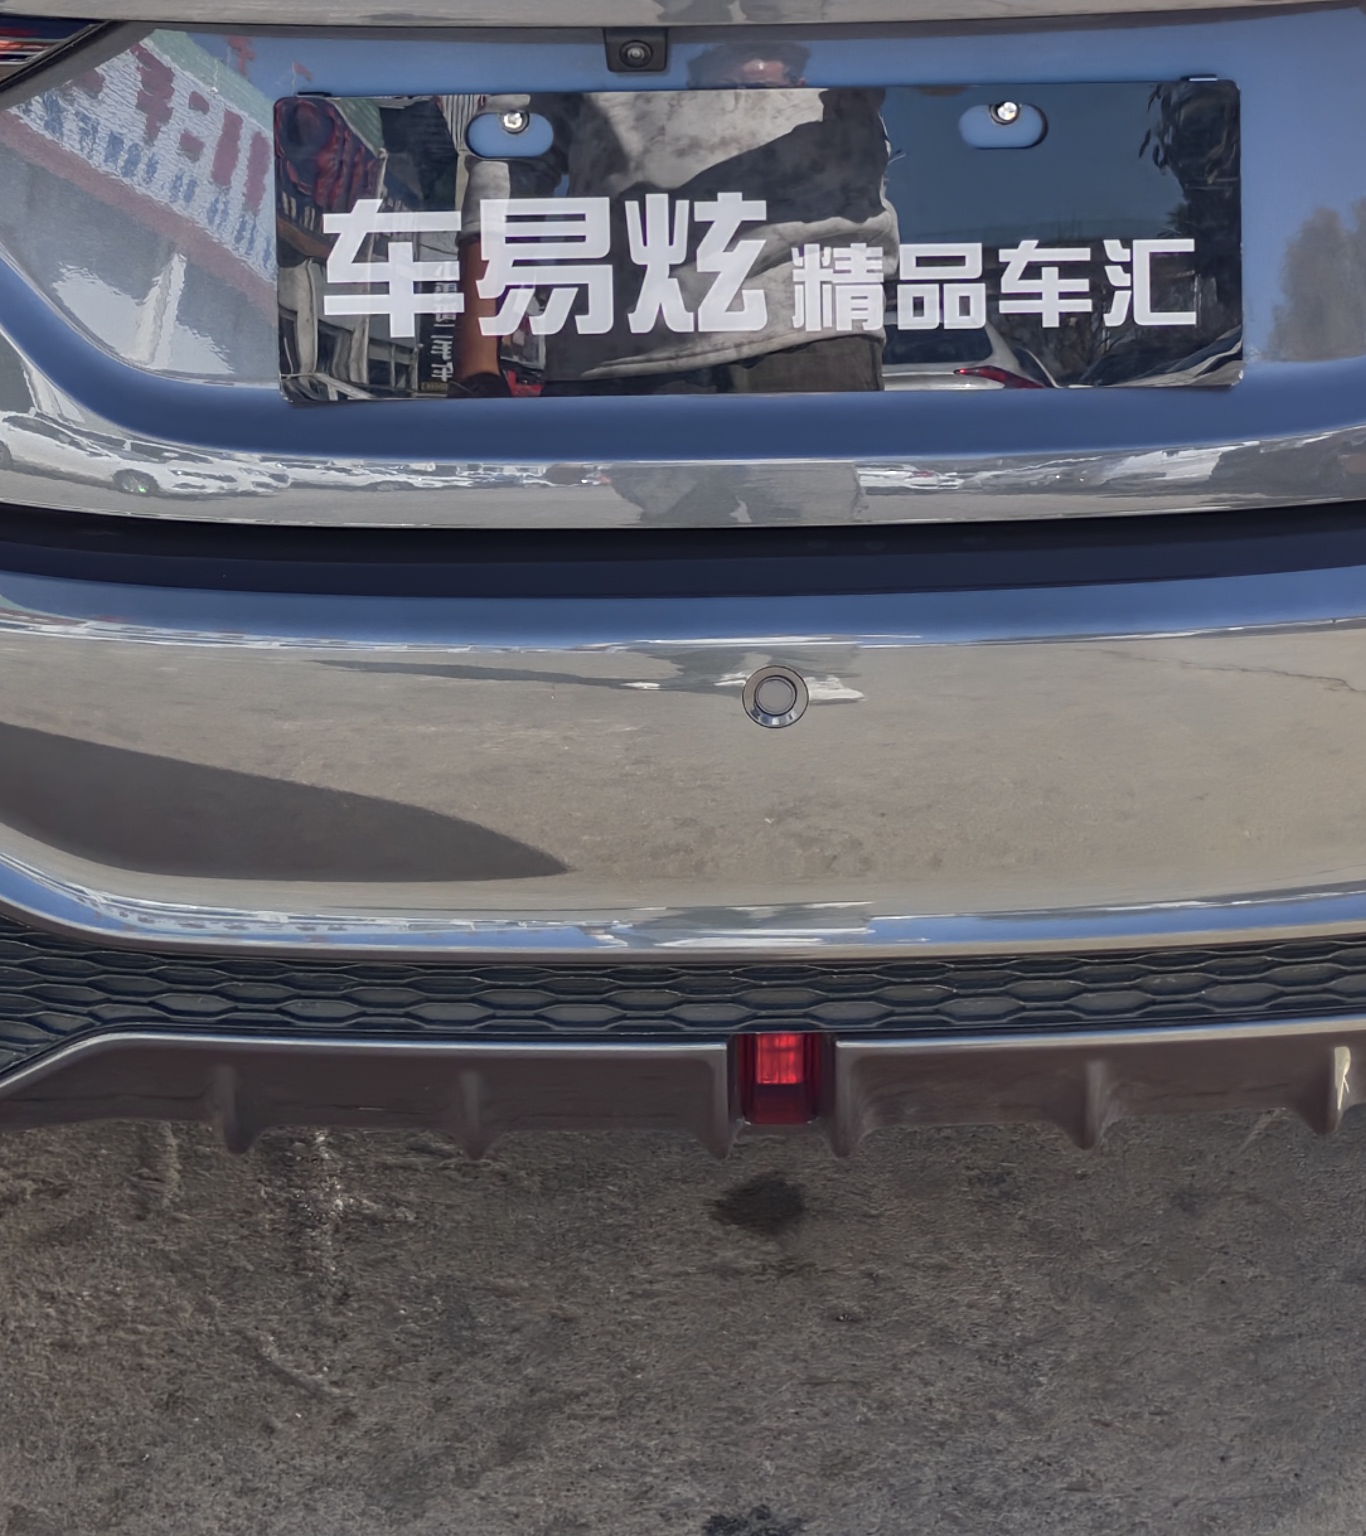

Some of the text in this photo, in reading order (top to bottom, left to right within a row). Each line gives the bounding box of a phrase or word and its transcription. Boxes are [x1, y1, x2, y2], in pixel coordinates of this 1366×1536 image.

[321, 191, 769, 339] 车易炫
[790, 237, 1197, 332] 精品车汇
